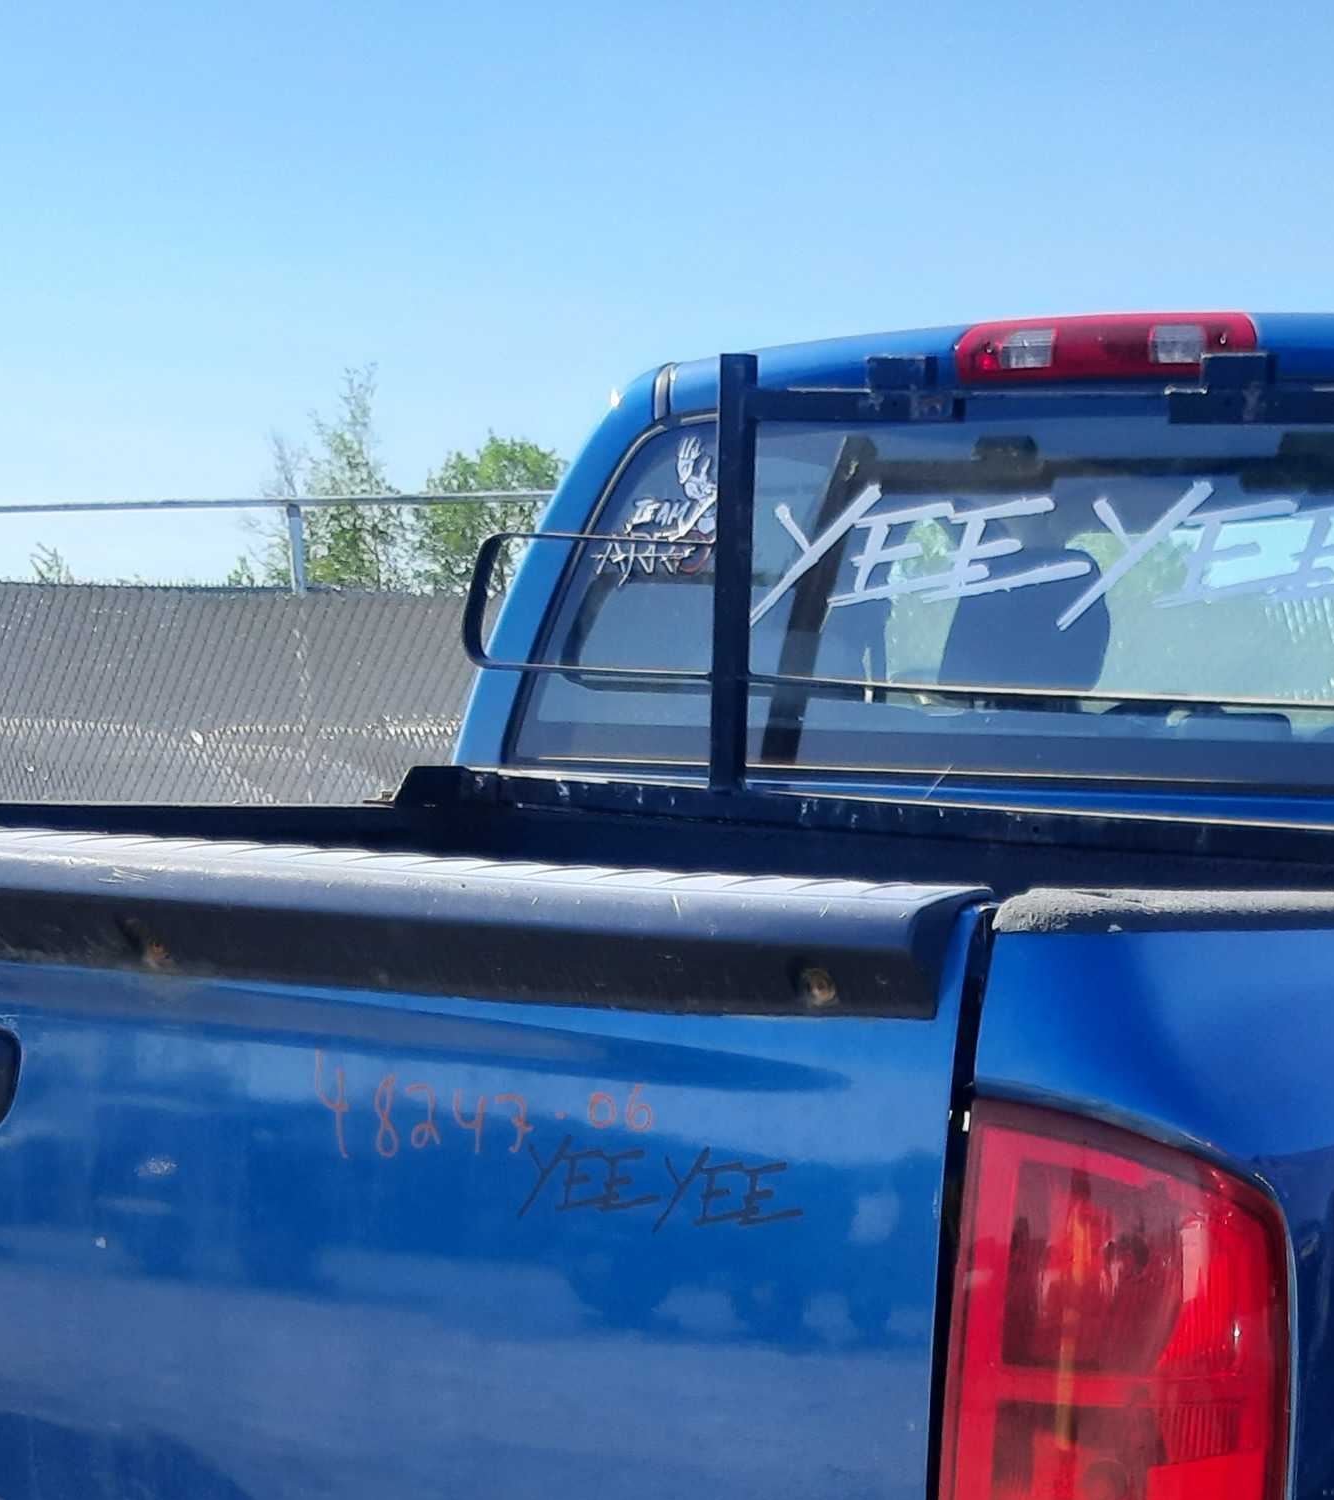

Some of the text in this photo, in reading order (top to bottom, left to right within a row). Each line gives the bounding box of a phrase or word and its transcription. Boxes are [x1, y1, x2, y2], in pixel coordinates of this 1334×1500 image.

[749, 483, 1092, 629] YEE
[518, 1134, 803, 1234] YEE YEE
